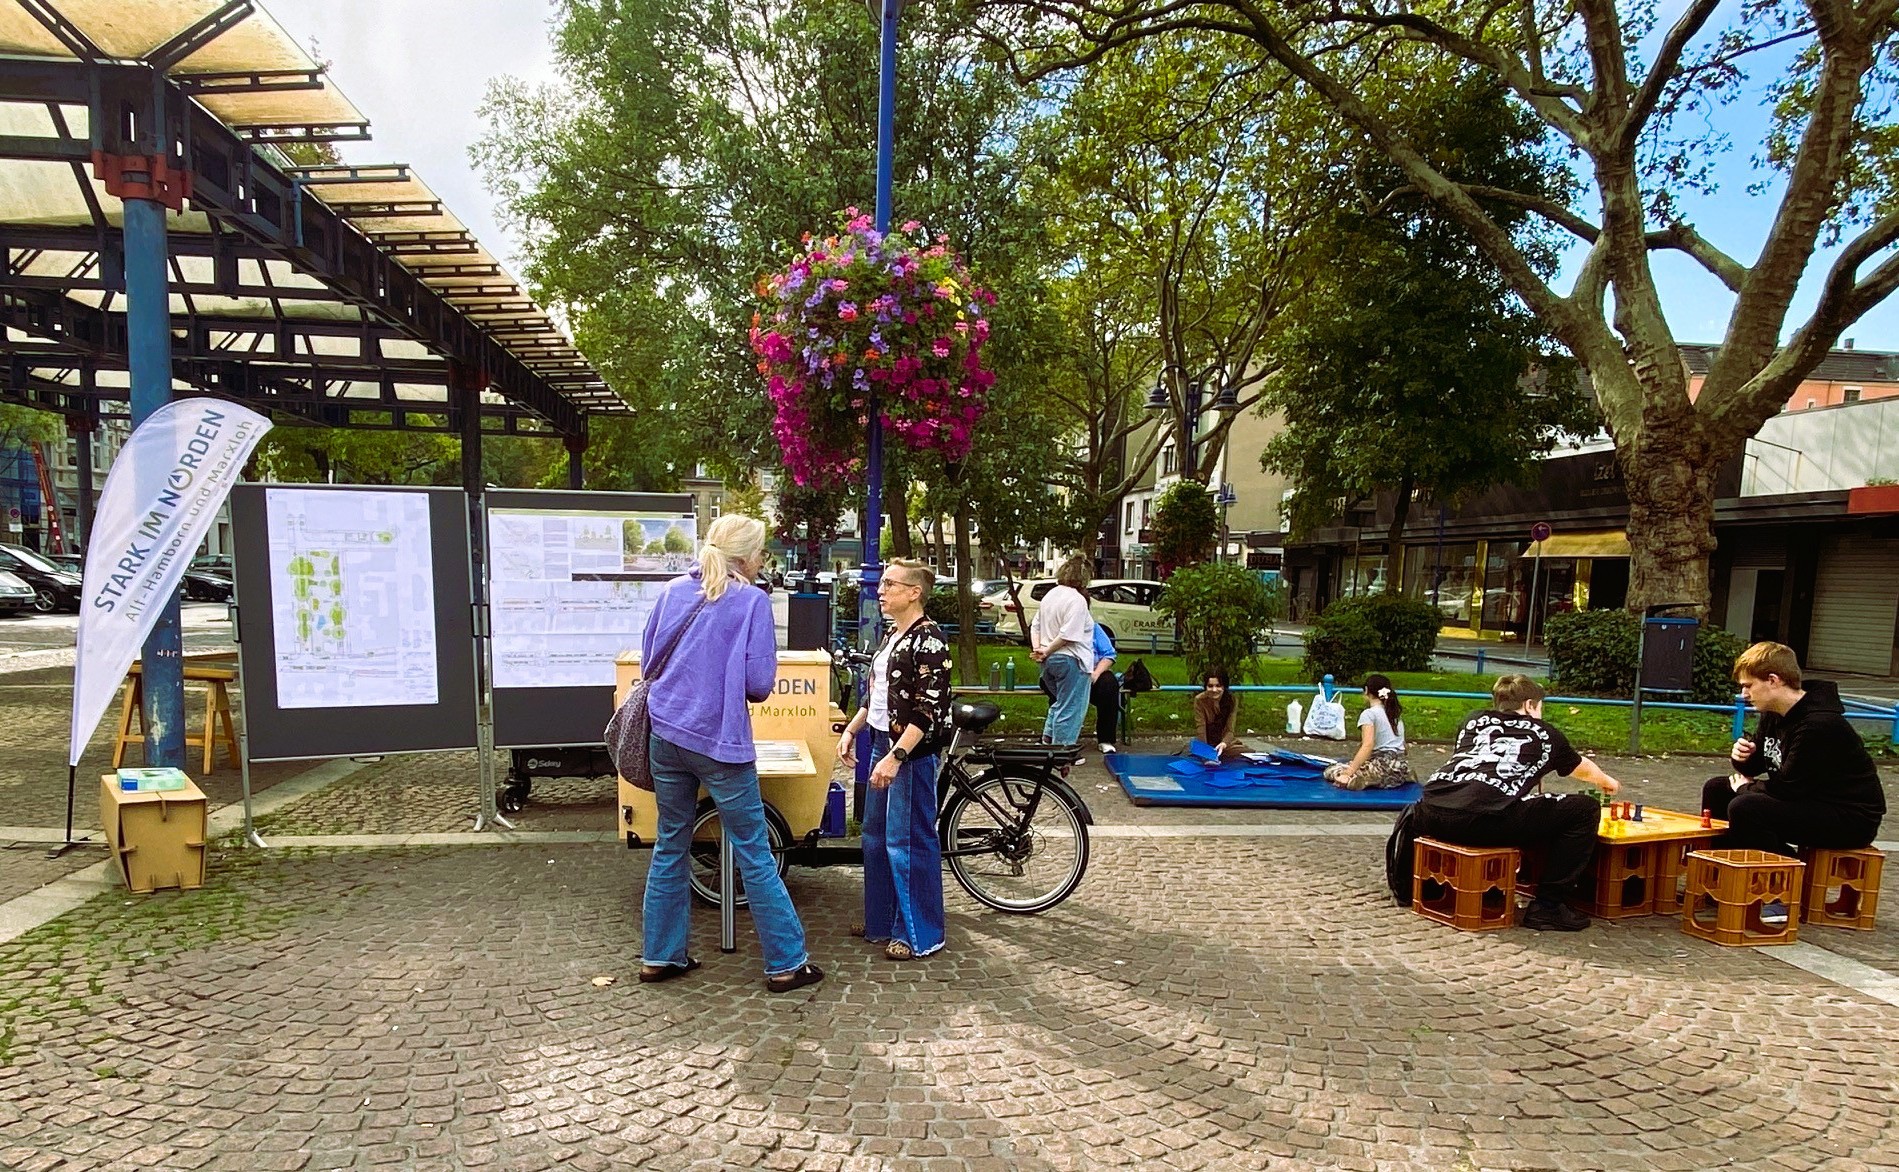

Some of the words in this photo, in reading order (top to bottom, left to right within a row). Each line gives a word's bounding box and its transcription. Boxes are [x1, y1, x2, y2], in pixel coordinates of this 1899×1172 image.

[94, 542, 150, 613] STARK
[138, 510, 170, 541] IM
[157, 409, 225, 508] NORDEN
[125, 522, 193, 622] Alt-Hamborn
[189, 487, 211, 517] und
[207, 420, 253, 483] Marxloh
[760, 705, 816, 717] Marxloh
[771, 678, 816, 695] DEN
